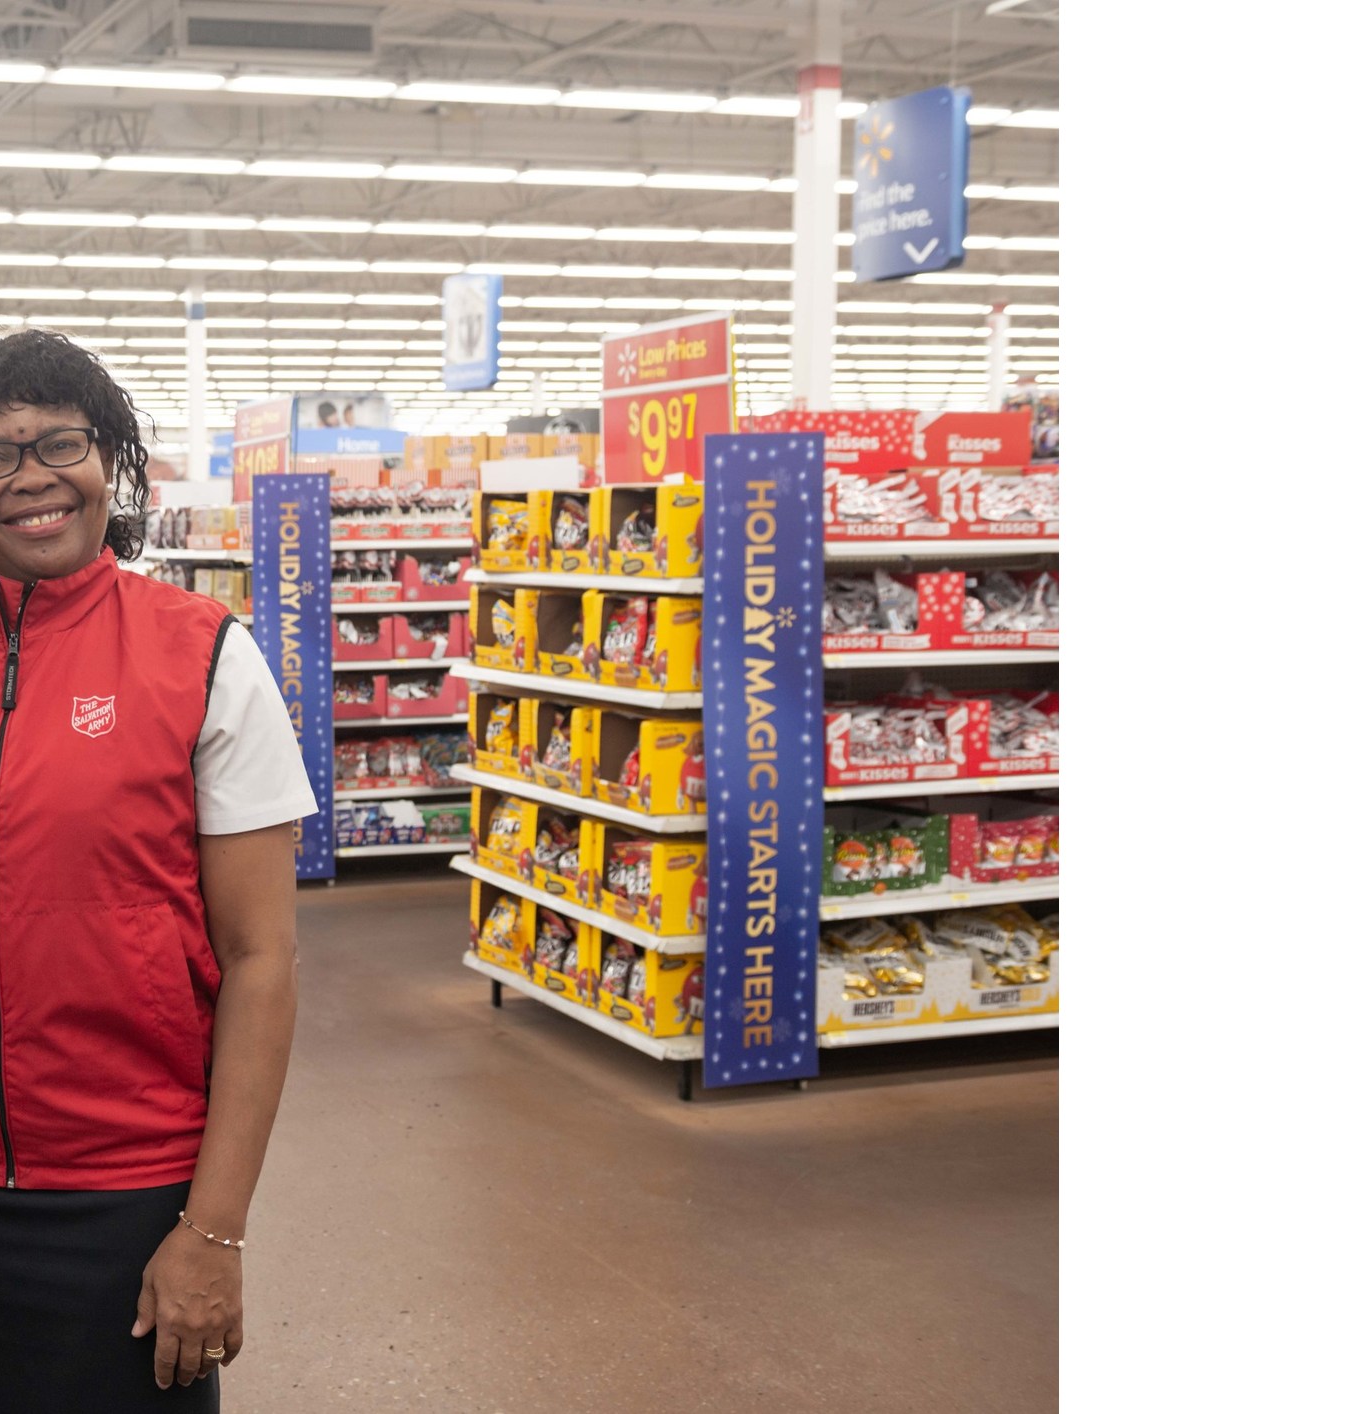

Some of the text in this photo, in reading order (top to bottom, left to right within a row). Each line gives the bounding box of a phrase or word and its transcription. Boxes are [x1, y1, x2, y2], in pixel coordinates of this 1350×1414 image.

[638, 337, 707, 367] Low Prices
[336, 437, 380, 453] Home
[280, 614, 303, 696] MAGIC
[74, 701, 111, 727] SALVATION
[80, 700, 98, 713] THE
[87, 712, 111, 733] ARMY
[744, 657, 779, 790] MAGIC
[745, 801, 779, 938] STARTS
[743, 945, 774, 1049] HERE
[853, 1000, 895, 1016] HERSHEY'S
[980, 989, 1021, 1005] HERSHEY'S
